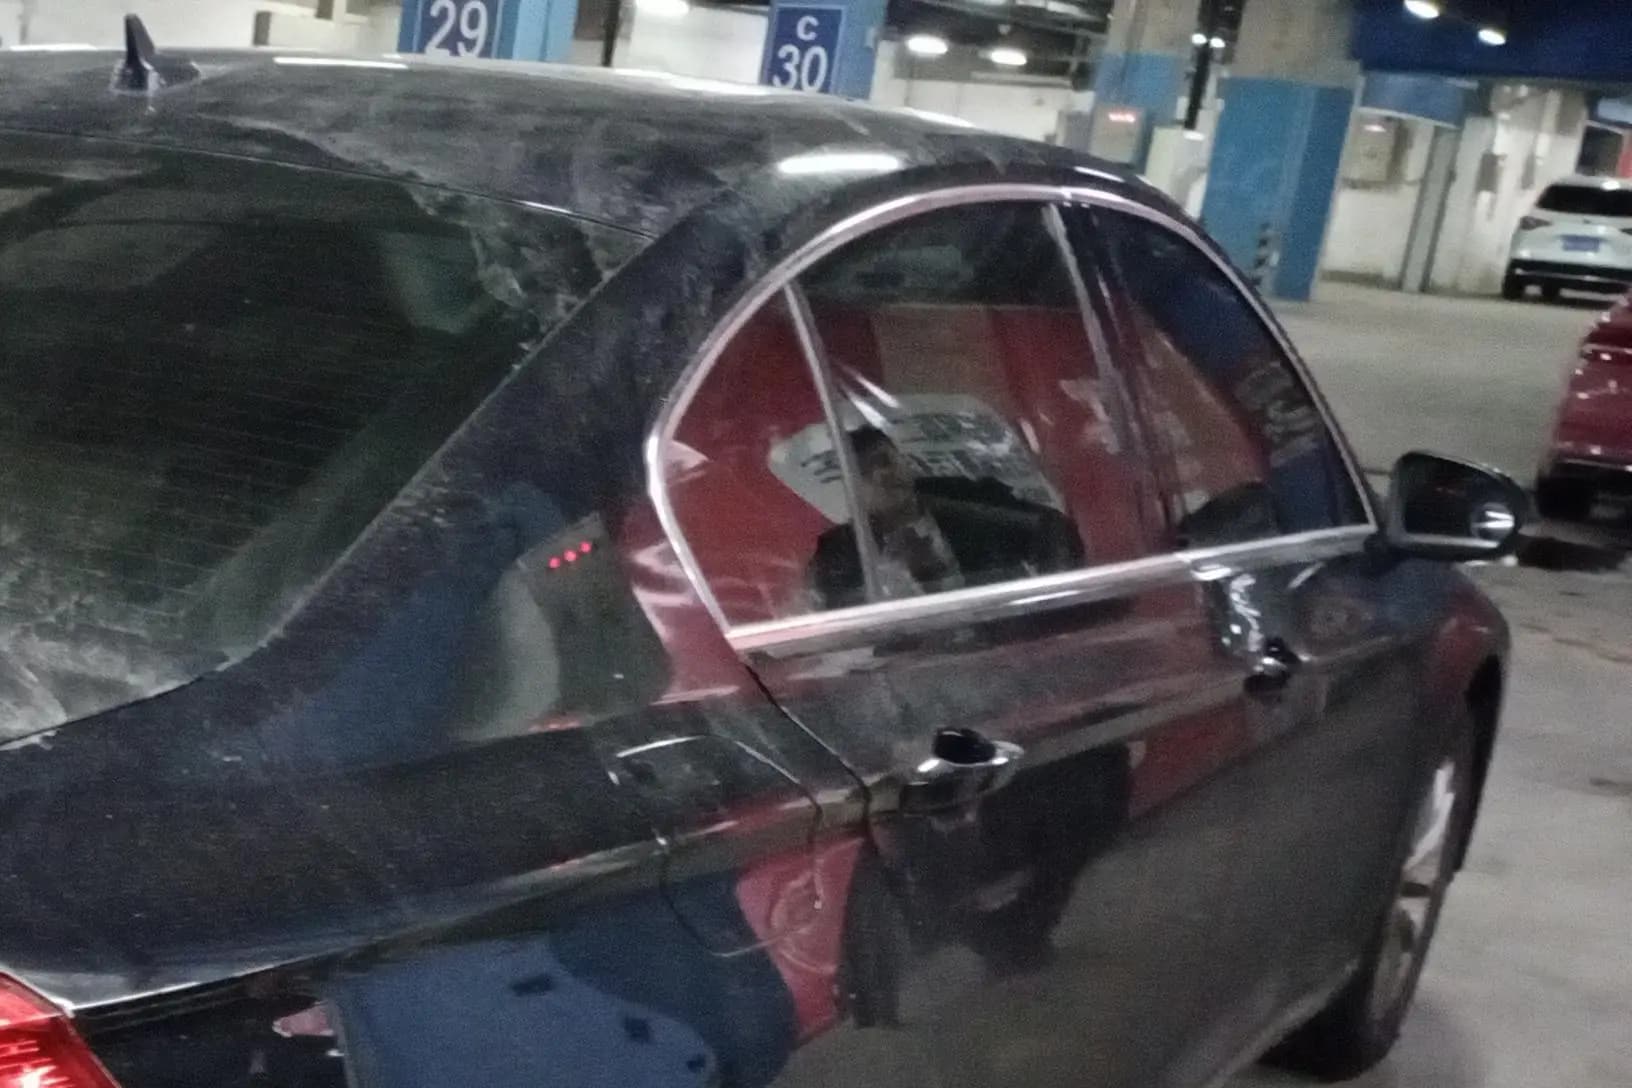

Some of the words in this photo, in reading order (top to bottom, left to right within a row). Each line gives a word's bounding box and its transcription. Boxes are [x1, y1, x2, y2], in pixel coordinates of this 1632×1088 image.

[425, 0, 487, 59] 29
[796, 15, 819, 41] C
[772, 44, 828, 92] 30
